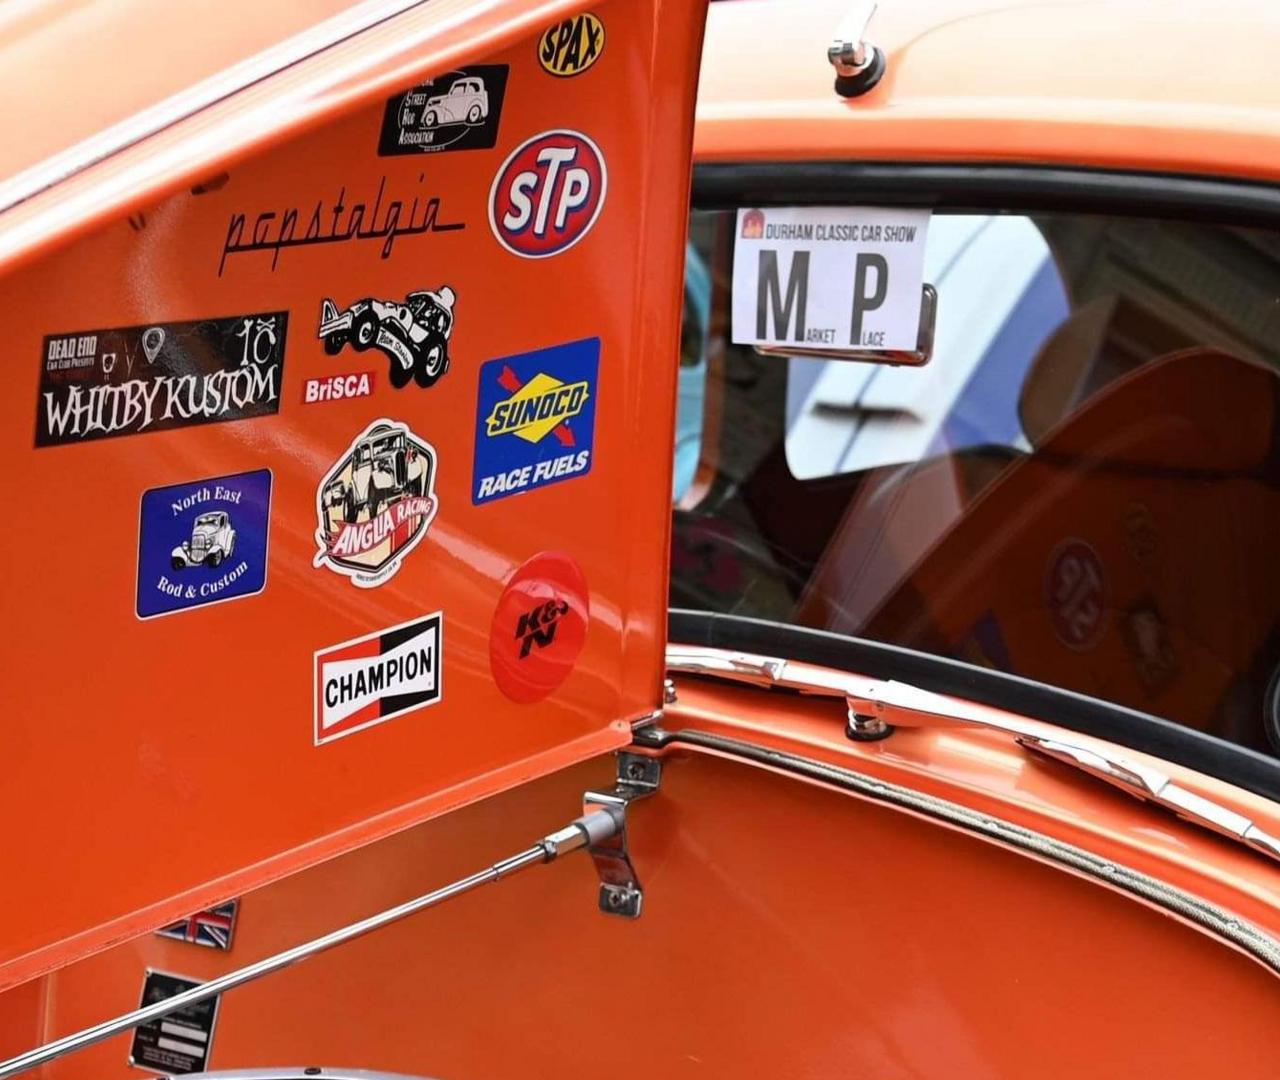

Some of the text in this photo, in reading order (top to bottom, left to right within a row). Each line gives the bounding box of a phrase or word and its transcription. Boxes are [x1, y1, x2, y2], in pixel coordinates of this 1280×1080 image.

[542, 16, 600, 73] SPAX
[503, 147, 591, 237] STP
[766, 223, 916, 242] DURHAM CLASSIC CAR SHOW
[48, 338, 76, 360] DEAD
[43, 363, 278, 437] WHITBY KUSTOM
[305, 373, 370, 403] BriSCA
[491, 385, 586, 433] SUNOCO
[477, 450, 589, 499] RACE FUELS
[171, 486, 242, 516] North East
[332, 500, 431, 555] ANGLIA RACING
[157, 561, 249, 599] Rod & Custom
[325, 646, 431, 708] CHAMPION
